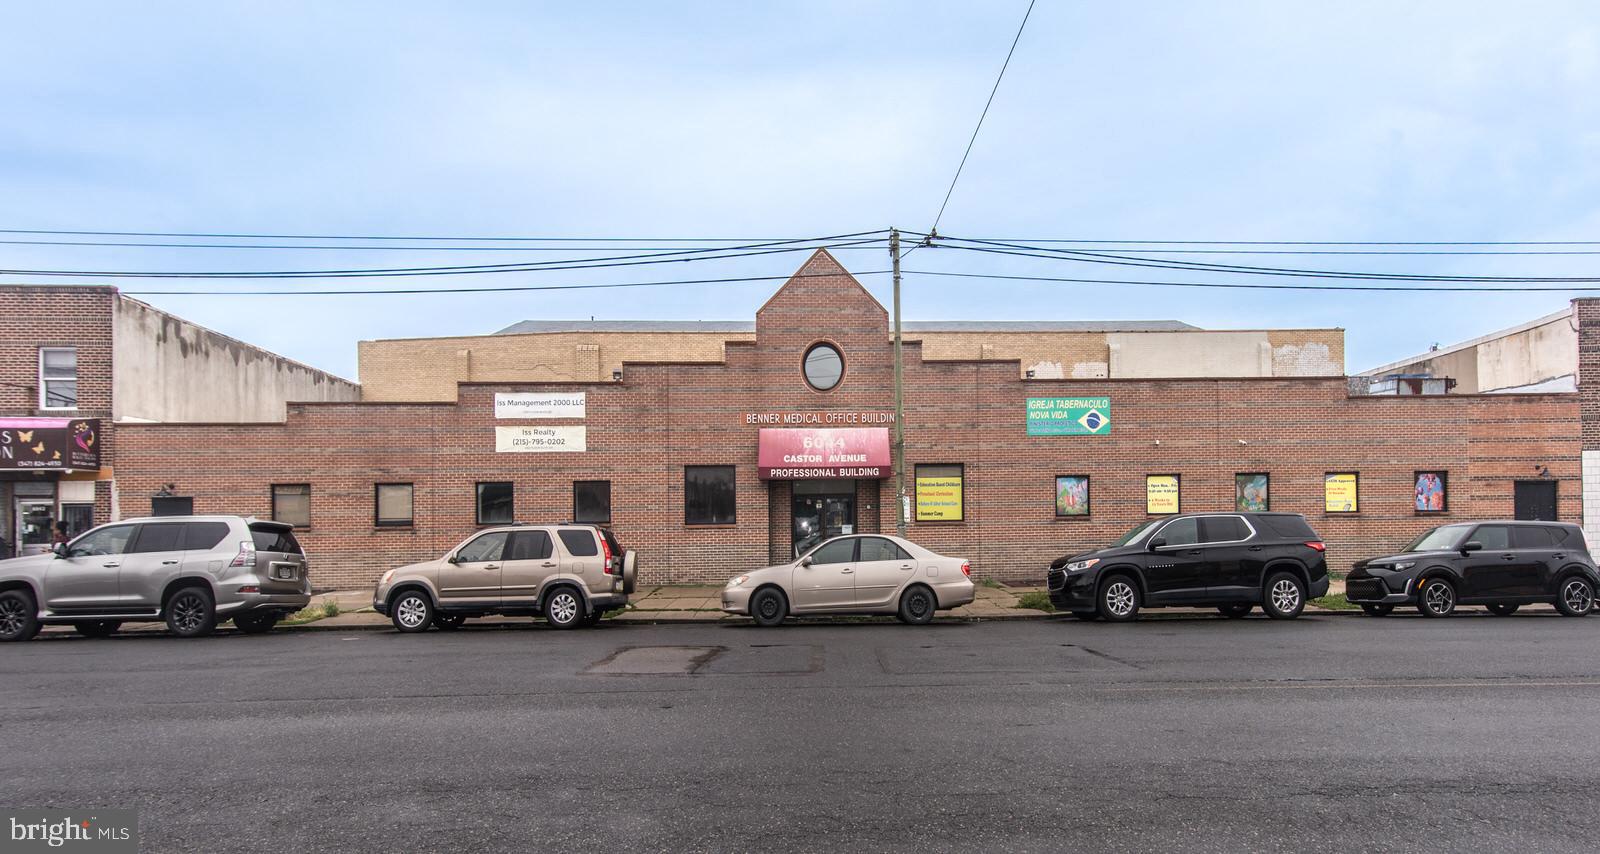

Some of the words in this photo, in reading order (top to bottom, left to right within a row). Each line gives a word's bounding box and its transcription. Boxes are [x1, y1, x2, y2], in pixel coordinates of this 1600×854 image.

[507, 399, 552, 407] Management
[1028, 400, 1054, 409] IGREJA
[1056, 400, 1108, 408] TABERNACULO
[746, 413, 780, 424] BENNER
[784, 413, 823, 424] MEDICAL
[826, 413, 858, 423] OFFICE
[861, 412, 895, 423] BUILDIN
[1029, 411, 1050, 419] NOVA
[783, 454, 822, 463] CASTOR
[828, 454, 867, 462] AVENUE
[770, 468, 836, 477] PROFESSIONAL
[839, 468, 880, 476] BUILDING
